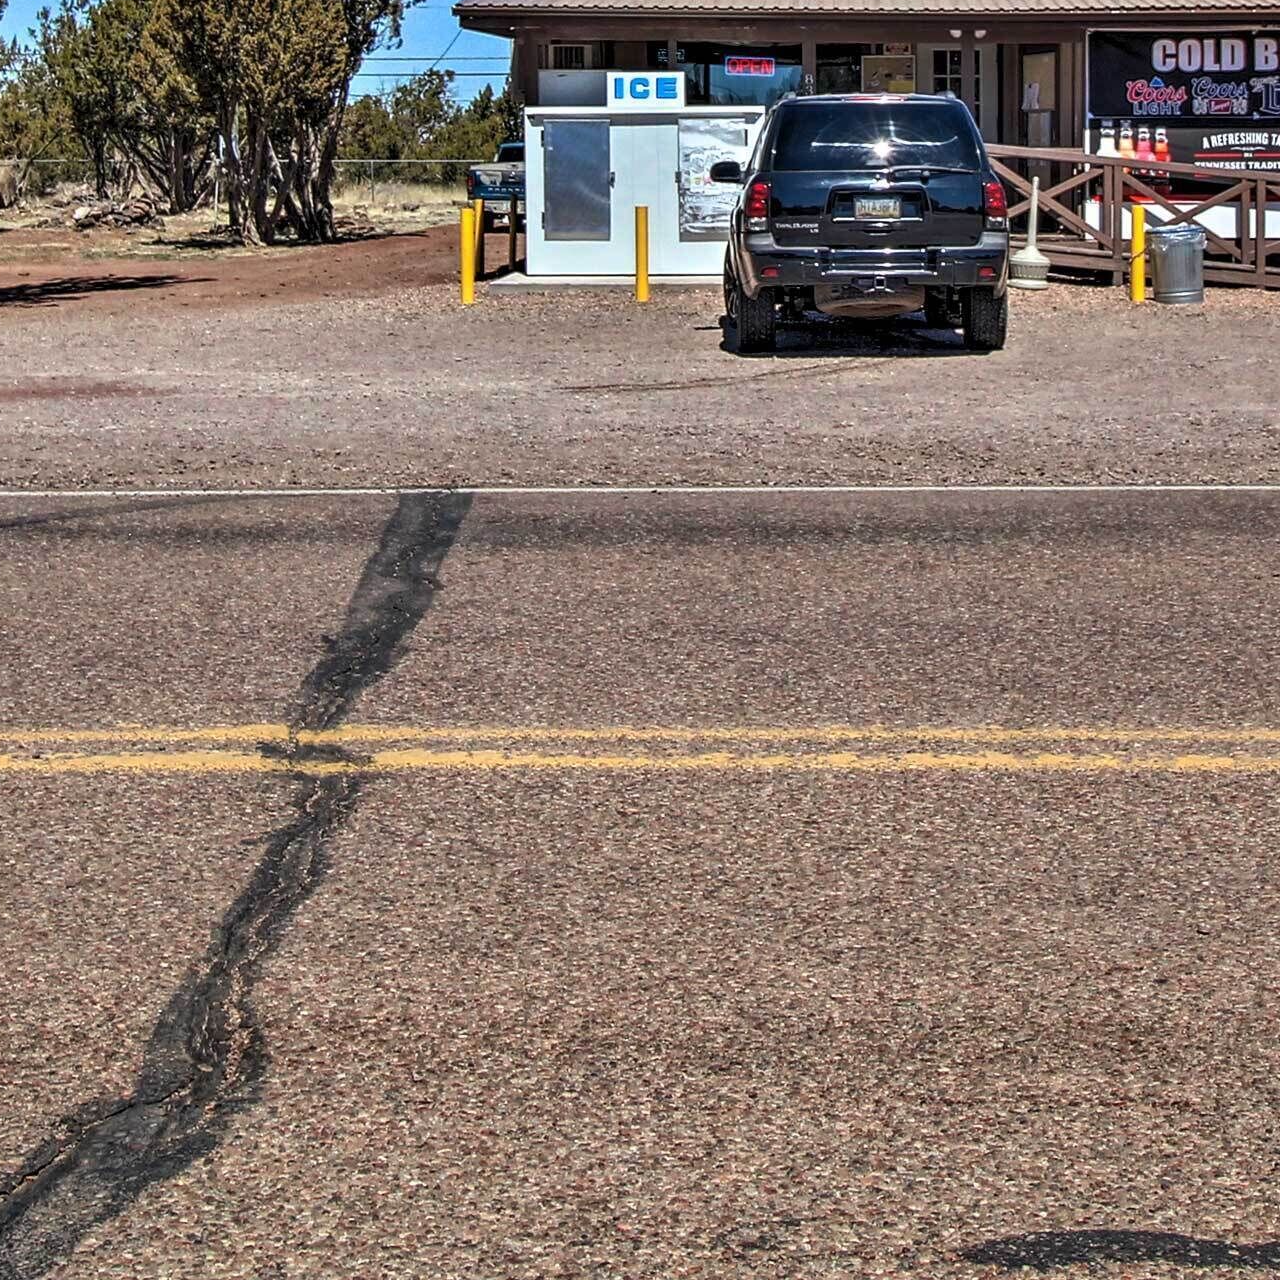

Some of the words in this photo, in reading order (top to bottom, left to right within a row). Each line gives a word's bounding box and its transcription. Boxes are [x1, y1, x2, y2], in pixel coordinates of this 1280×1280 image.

[728, 58, 772, 74] OPEN
[1152, 38, 1247, 71] COLD
[614, 77, 678, 100] ICE
[1126, 80, 1188, 103] Coors
[1191, 76, 1248, 99] Coors
[1133, 102, 1182, 116] LIGHT
[1202, 136, 1210, 149] A
[1210, 132, 1269, 148] REFRESHING
